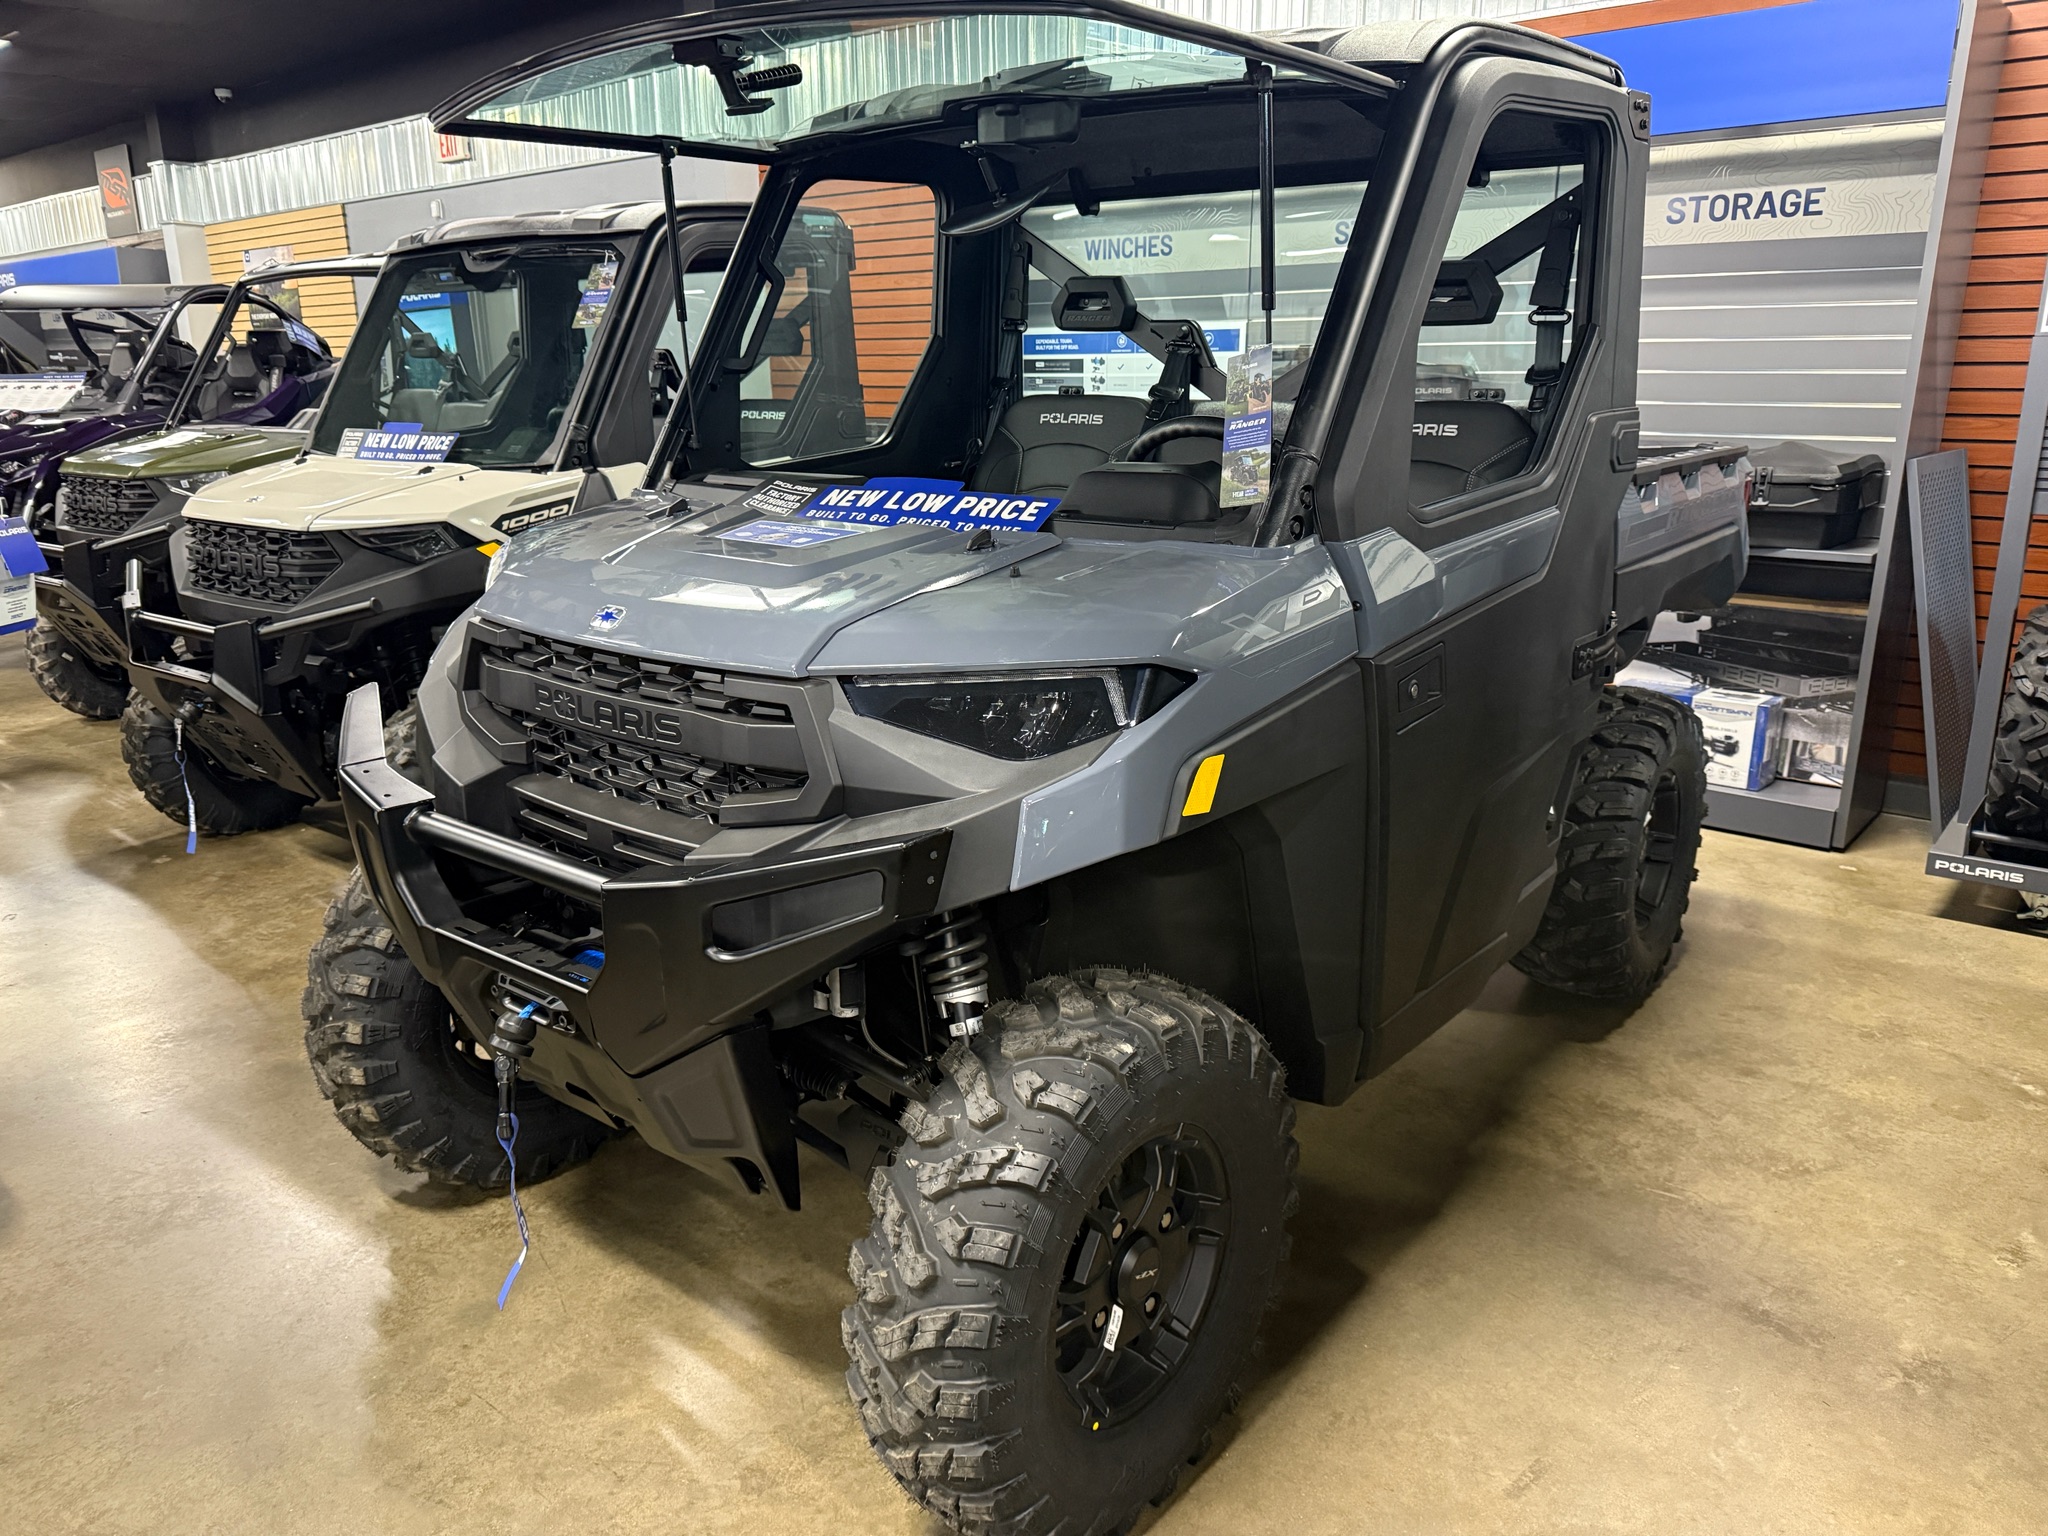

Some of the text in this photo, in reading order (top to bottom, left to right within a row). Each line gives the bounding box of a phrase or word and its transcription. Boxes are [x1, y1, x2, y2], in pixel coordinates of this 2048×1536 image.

[439, 134, 457, 158] EXIT
[1666, 187, 1826, 225] STORAGE
[1335, 220, 1355, 245] S
[1084, 234, 1173, 261] WINCHES
[741, 410, 786, 420] POLARIS
[1040, 412, 1104, 425] POLARIS
[1229, 417, 1267, 431] RANGER
[364, 432, 455, 451] NEW LOW PRICE
[766, 489, 803, 502] FACTORY
[773, 480, 818, 493] POLARIS
[61, 490, 118, 513] POLARIS
[749, 499, 791, 514] CLEARANCE
[752, 493, 801, 509] AUTHORIZED
[819, 488, 1050, 523] NEW LOW PRICE
[501, 503, 570, 531] 1000
[806, 508, 846, 519] BUILT
[849, 511, 866, 521] TO
[870, 513, 891, 524] GO.
[896, 516, 950, 529] PRICED
[954, 521, 975, 532] TO
[185, 543, 279, 578] POLARIS
[1220, 579, 1336, 654] XP
[534, 682, 683, 746] POLARIS
[1694, 704, 1753, 717] SPORTSMAN
[1934, 859, 2025, 884] POLARIS
